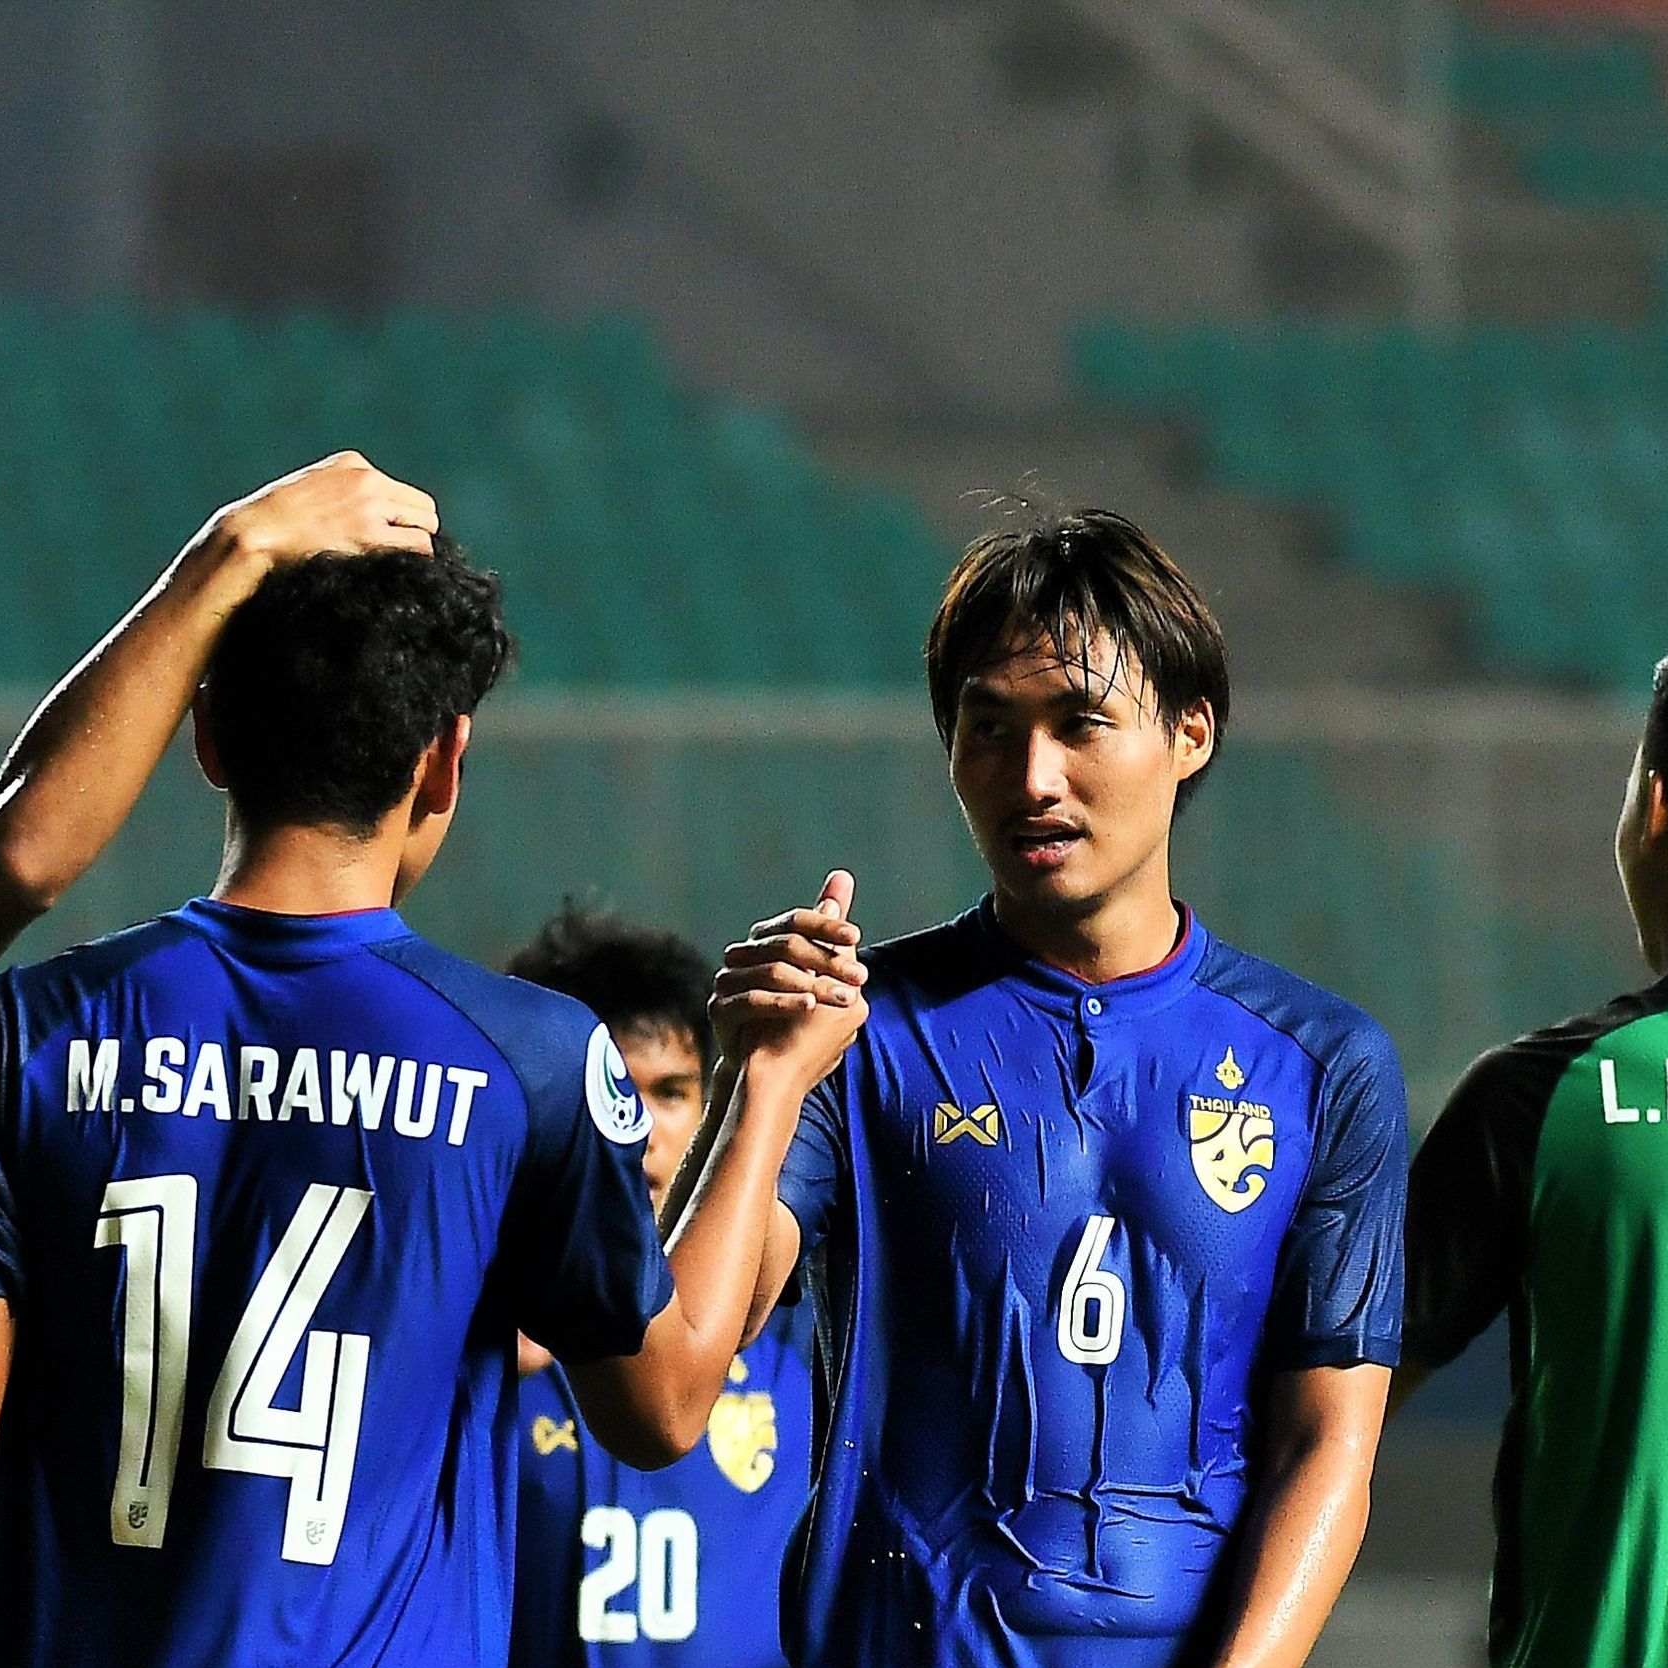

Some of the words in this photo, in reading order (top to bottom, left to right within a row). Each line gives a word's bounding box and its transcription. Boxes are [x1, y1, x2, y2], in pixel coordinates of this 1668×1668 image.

[66, 1036, 488, 1146] M.SARAWUT
[1189, 1094, 1272, 1120] THAILAND
[1057, 1214, 1126, 1365] 6
[93, 1174, 375, 1566] 14
[578, 1504, 698, 1643] 20
